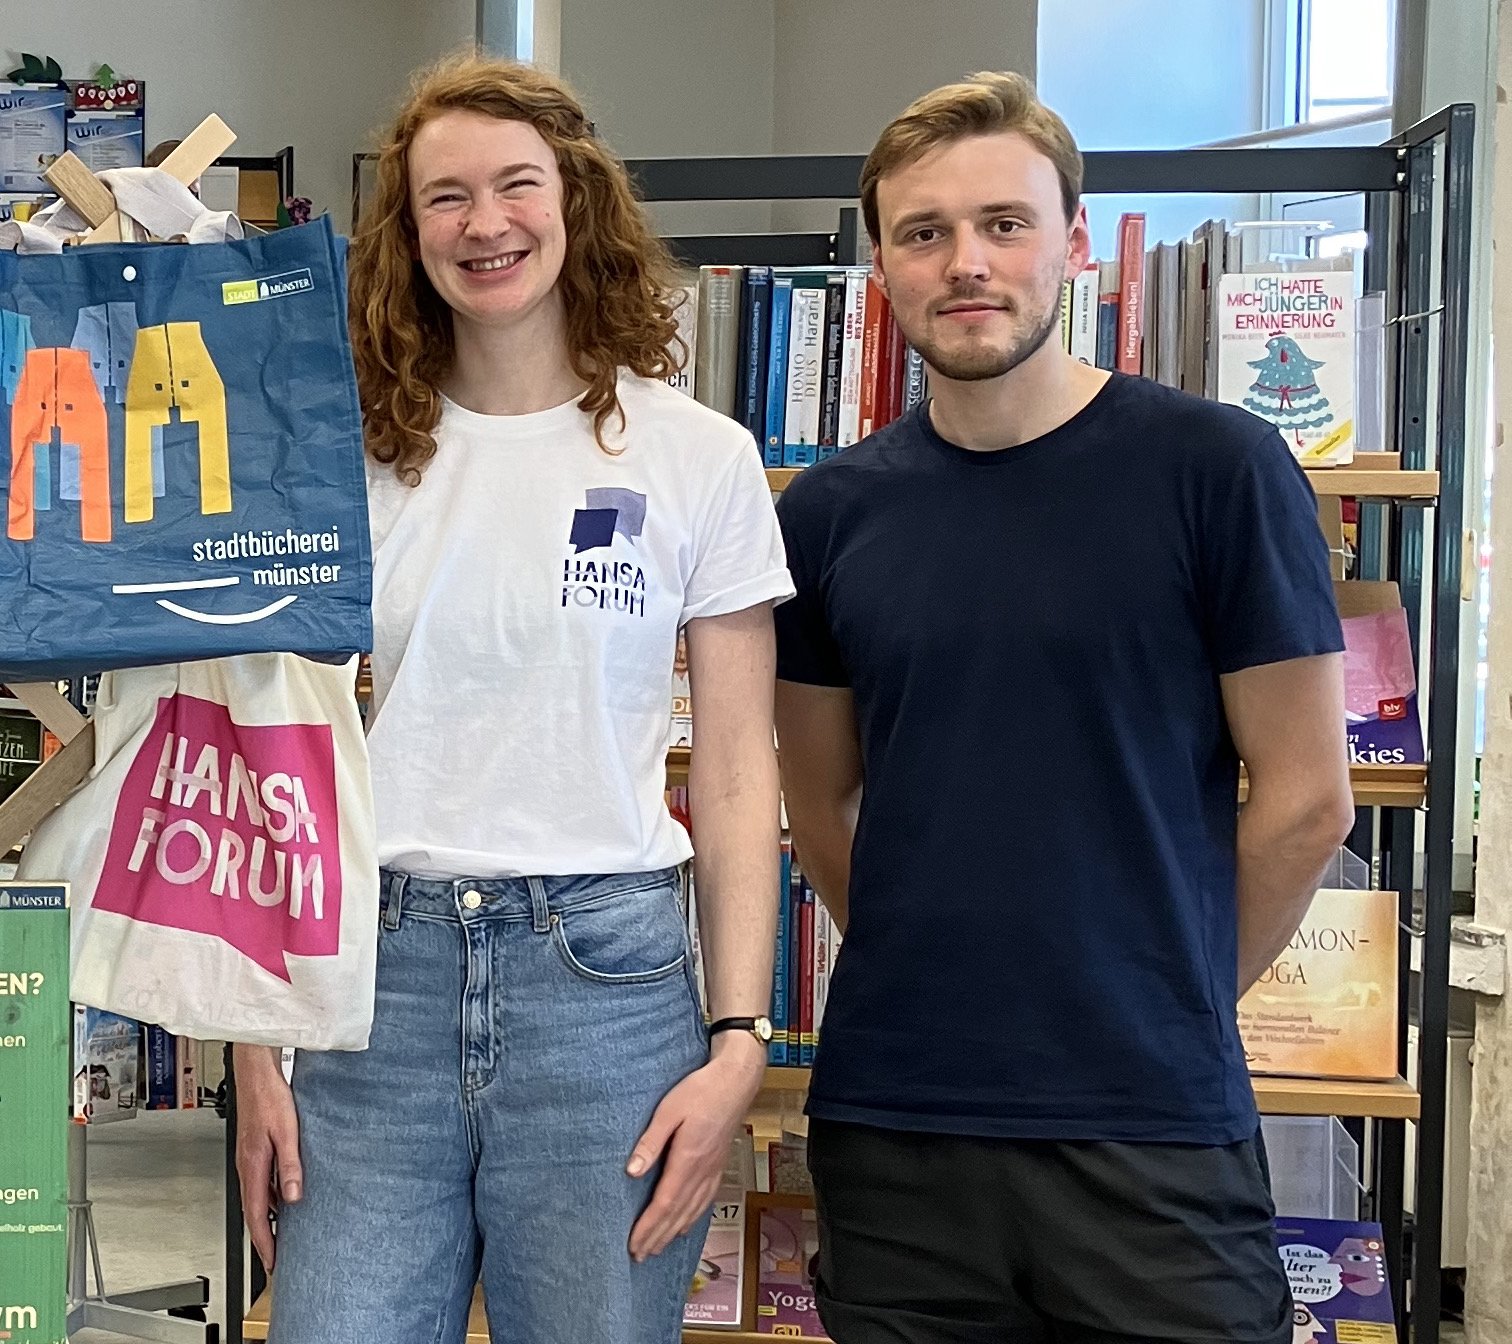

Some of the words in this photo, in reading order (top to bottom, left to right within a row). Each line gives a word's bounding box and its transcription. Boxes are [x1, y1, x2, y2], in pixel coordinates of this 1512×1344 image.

[227, 288, 256, 302] STADT
[269, 277, 311, 295] MÜNSTER
[1255, 277, 1279, 292] ICH
[1281, 279, 1324, 294] HATTE
[1227, 293, 1262, 307] MICH
[1259, 292, 1328, 313] JÜNGER
[1330, 297, 1343, 310] IN
[804, 300, 818, 346] Harari
[846, 313, 854, 339] LEBEN
[1126, 281, 1139, 358] Hiergeblieben!
[1236, 313, 1335, 329] ERINNERUNG
[854, 326, 862, 339] BIS
[791, 353, 804, 403] HOMO
[804, 358, 818, 397] DEUS
[192, 526, 340, 562] stadtbücherei
[253, 561, 341, 586] münster
[564, 559, 645, 591] HANSA
[561, 584, 645, 617] FORUM
[1349, 743, 1405, 763] kies
[151, 732, 319, 844] HANSA
[127, 807, 324, 920] FORUM
[12, 895, 62, 907] MÜNSTER
[1257, 961, 1307, 985] OGA
[1287, 1259, 1316, 1272] lter
[1292, 1285, 1333, 1296] tten?!
